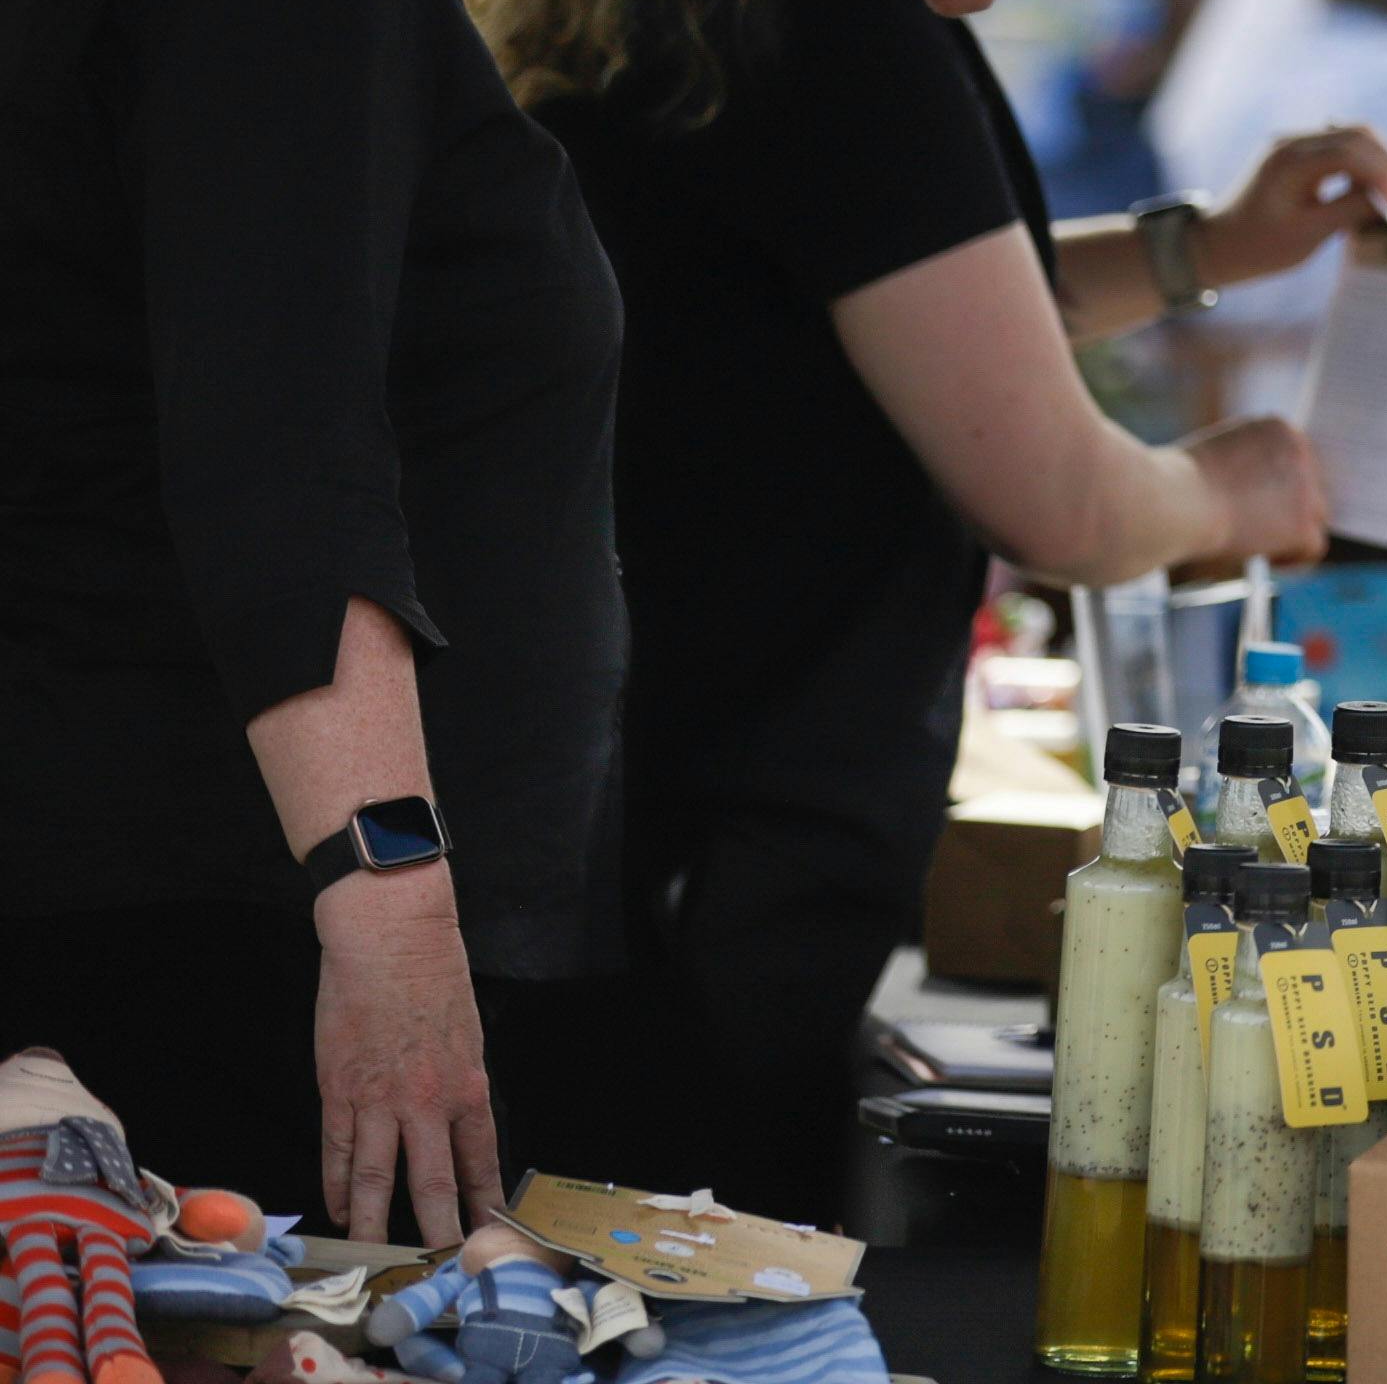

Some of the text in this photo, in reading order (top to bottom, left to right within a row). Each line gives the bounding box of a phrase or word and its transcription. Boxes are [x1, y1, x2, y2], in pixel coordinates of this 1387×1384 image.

[1360, 952, 1384, 1082] POPPY SEED DRESSING
